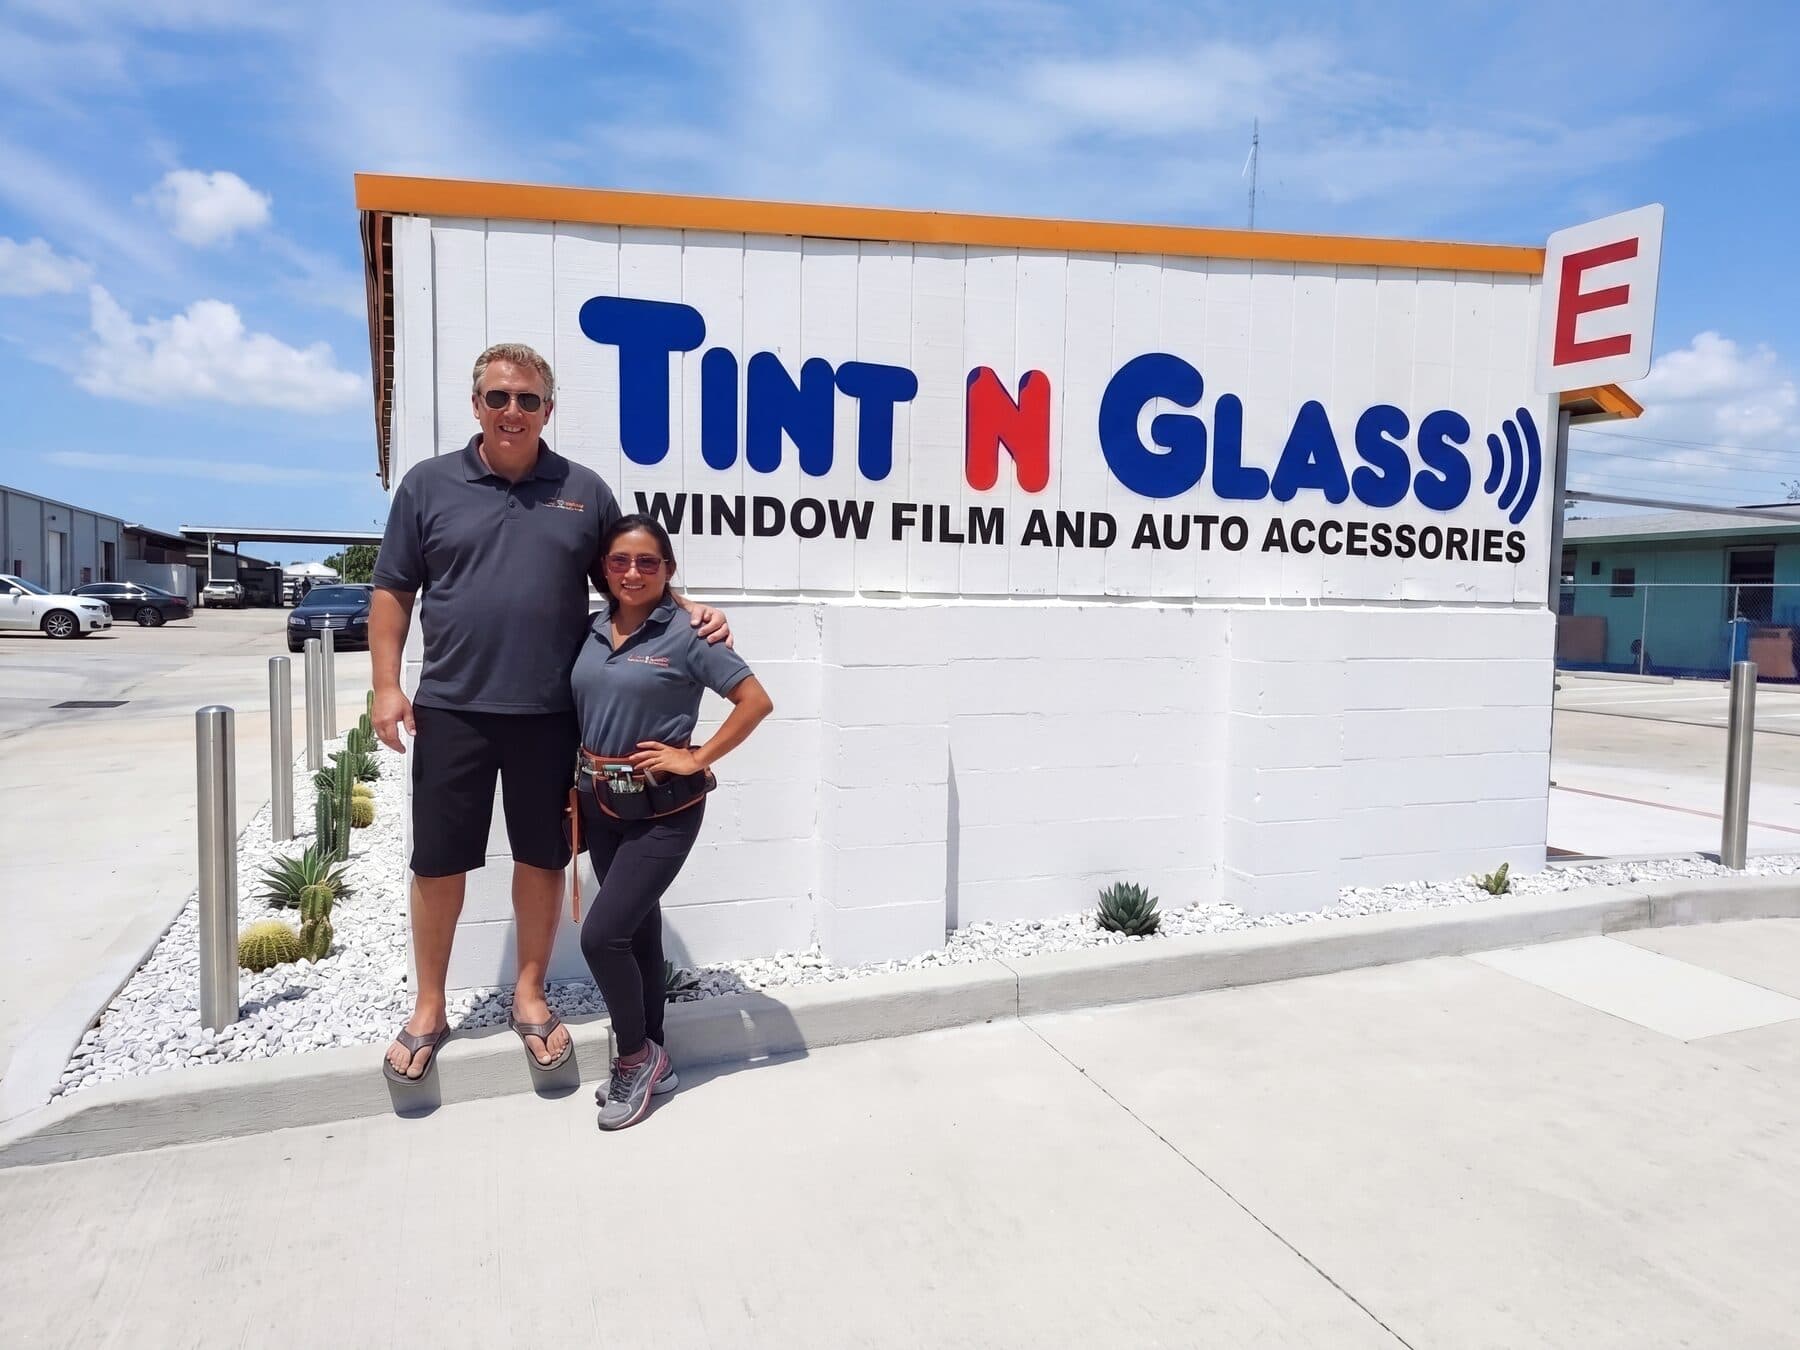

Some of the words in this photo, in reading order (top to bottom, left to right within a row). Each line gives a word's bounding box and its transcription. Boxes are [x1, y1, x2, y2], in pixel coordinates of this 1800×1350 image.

[1553, 237, 1639, 366] E
[965, 365, 1052, 494] N
[633, 491, 875, 540] WINDOW
[891, 502, 1005, 546] FILM
[1020, 509, 1118, 549] AND
[1131, 513, 1249, 552] AUTO
[1261, 517, 1526, 564] ACCESSORIES
